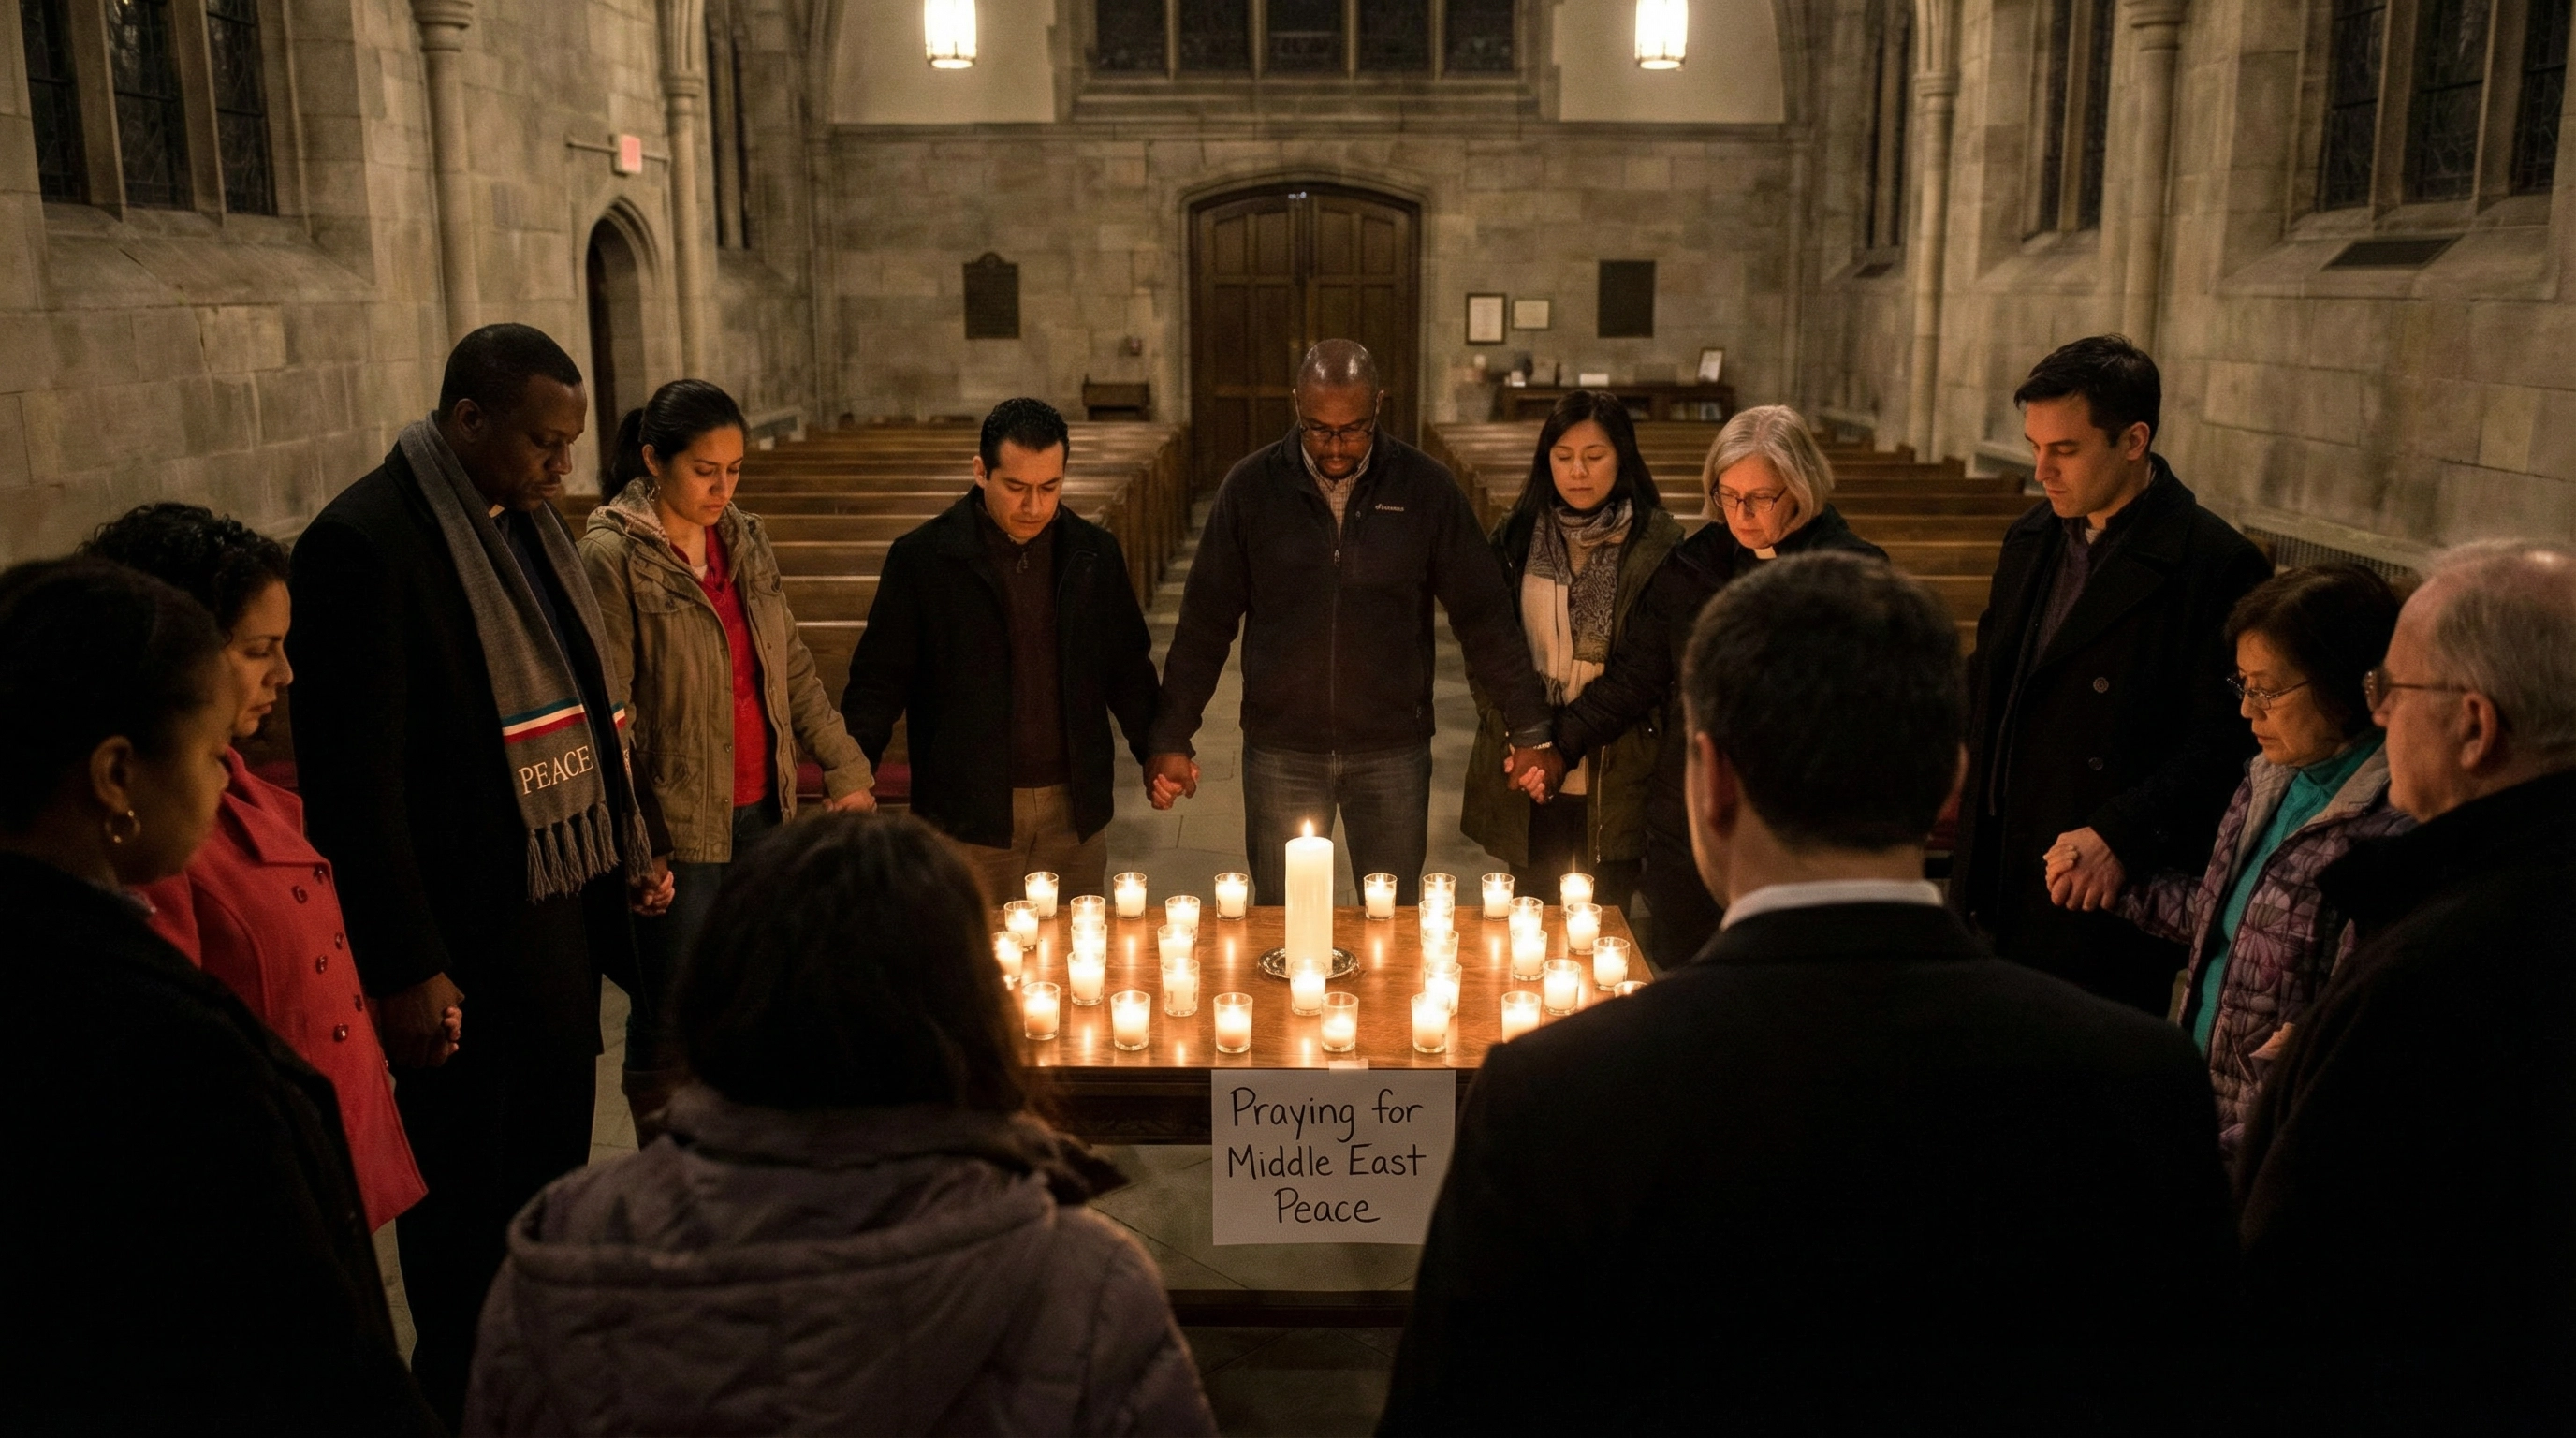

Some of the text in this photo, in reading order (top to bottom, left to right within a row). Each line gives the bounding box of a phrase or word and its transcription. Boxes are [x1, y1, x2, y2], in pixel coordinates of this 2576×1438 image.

[518, 745, 593, 795] PEACE
[1230, 1086, 1424, 1143] Praying for
[1228, 1143, 1427, 1180] Middle East
[1274, 1187, 1381, 1224] Peace
